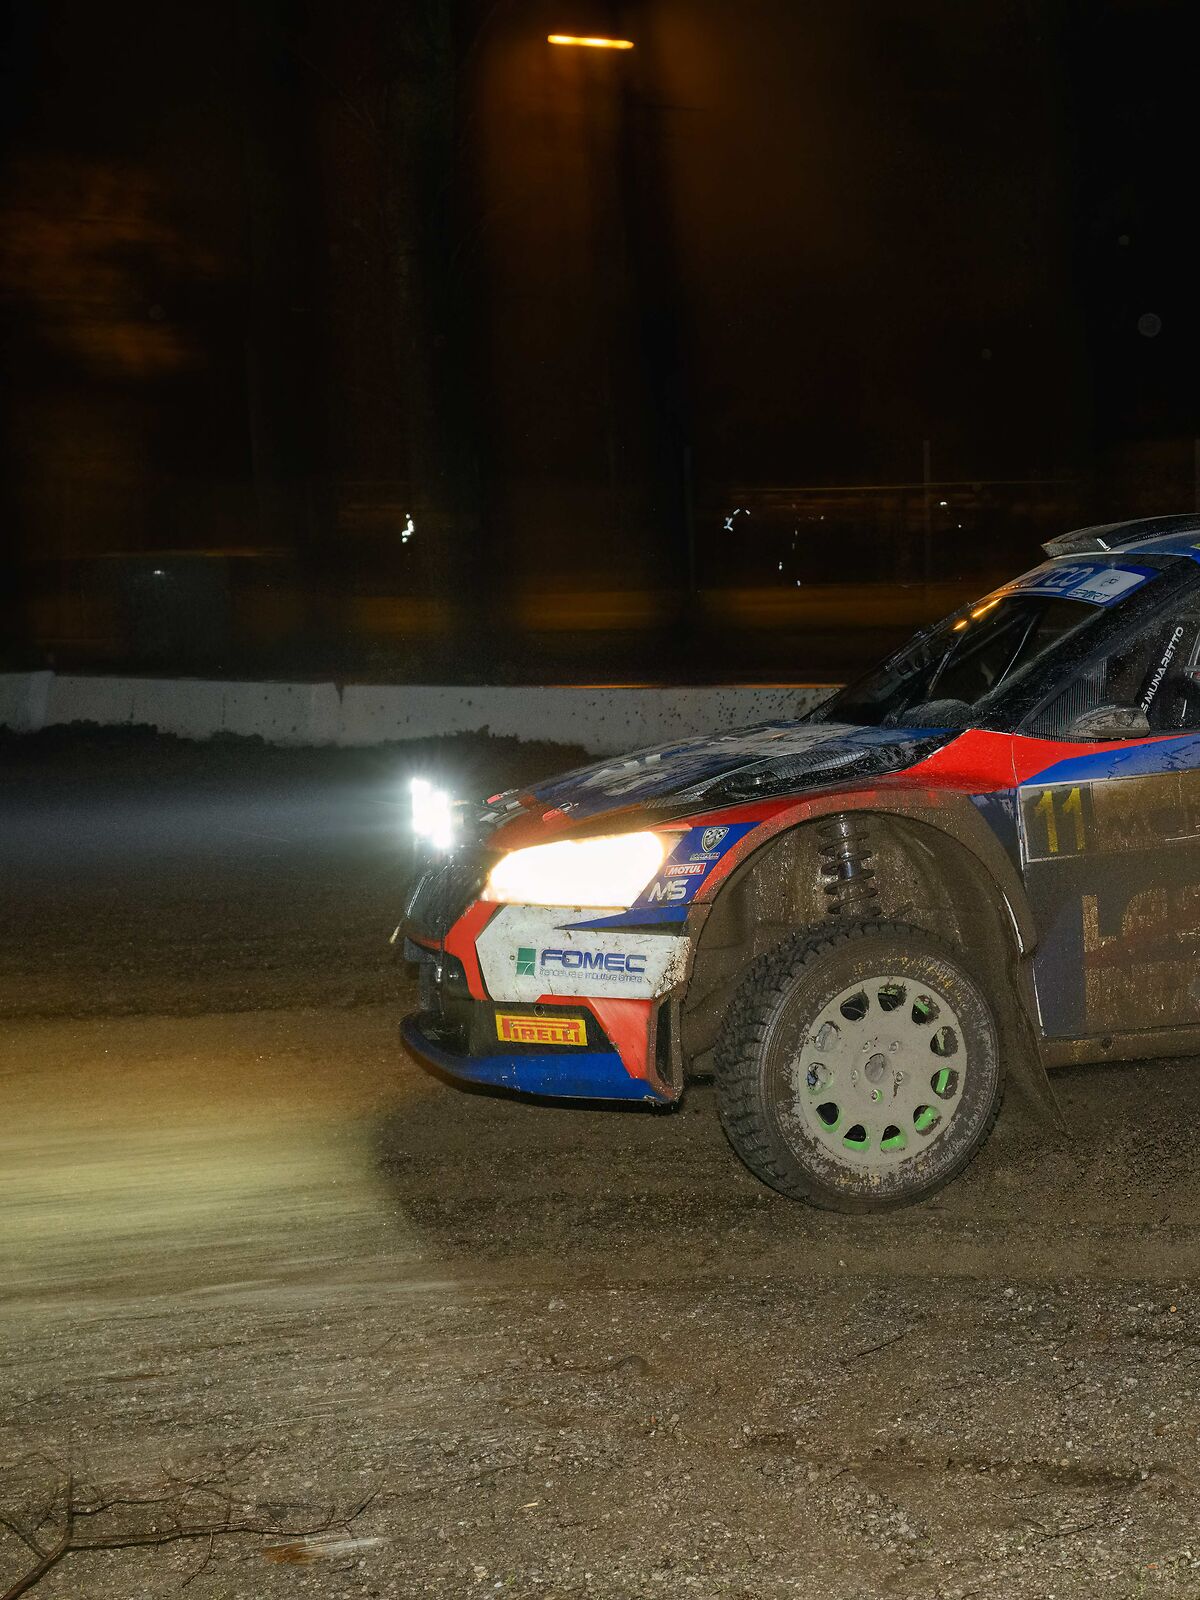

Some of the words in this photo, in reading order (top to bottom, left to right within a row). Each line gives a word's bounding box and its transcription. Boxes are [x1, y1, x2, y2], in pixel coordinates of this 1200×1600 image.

[1144, 626, 1184, 704] MUNARETTO
[1034, 787, 1086, 853] 11
[667, 865, 702, 876] MOTUL
[647, 879, 690, 902] MS
[540, 949, 648, 973] FOMEC
[502, 1018, 581, 1042] PIRELLI
